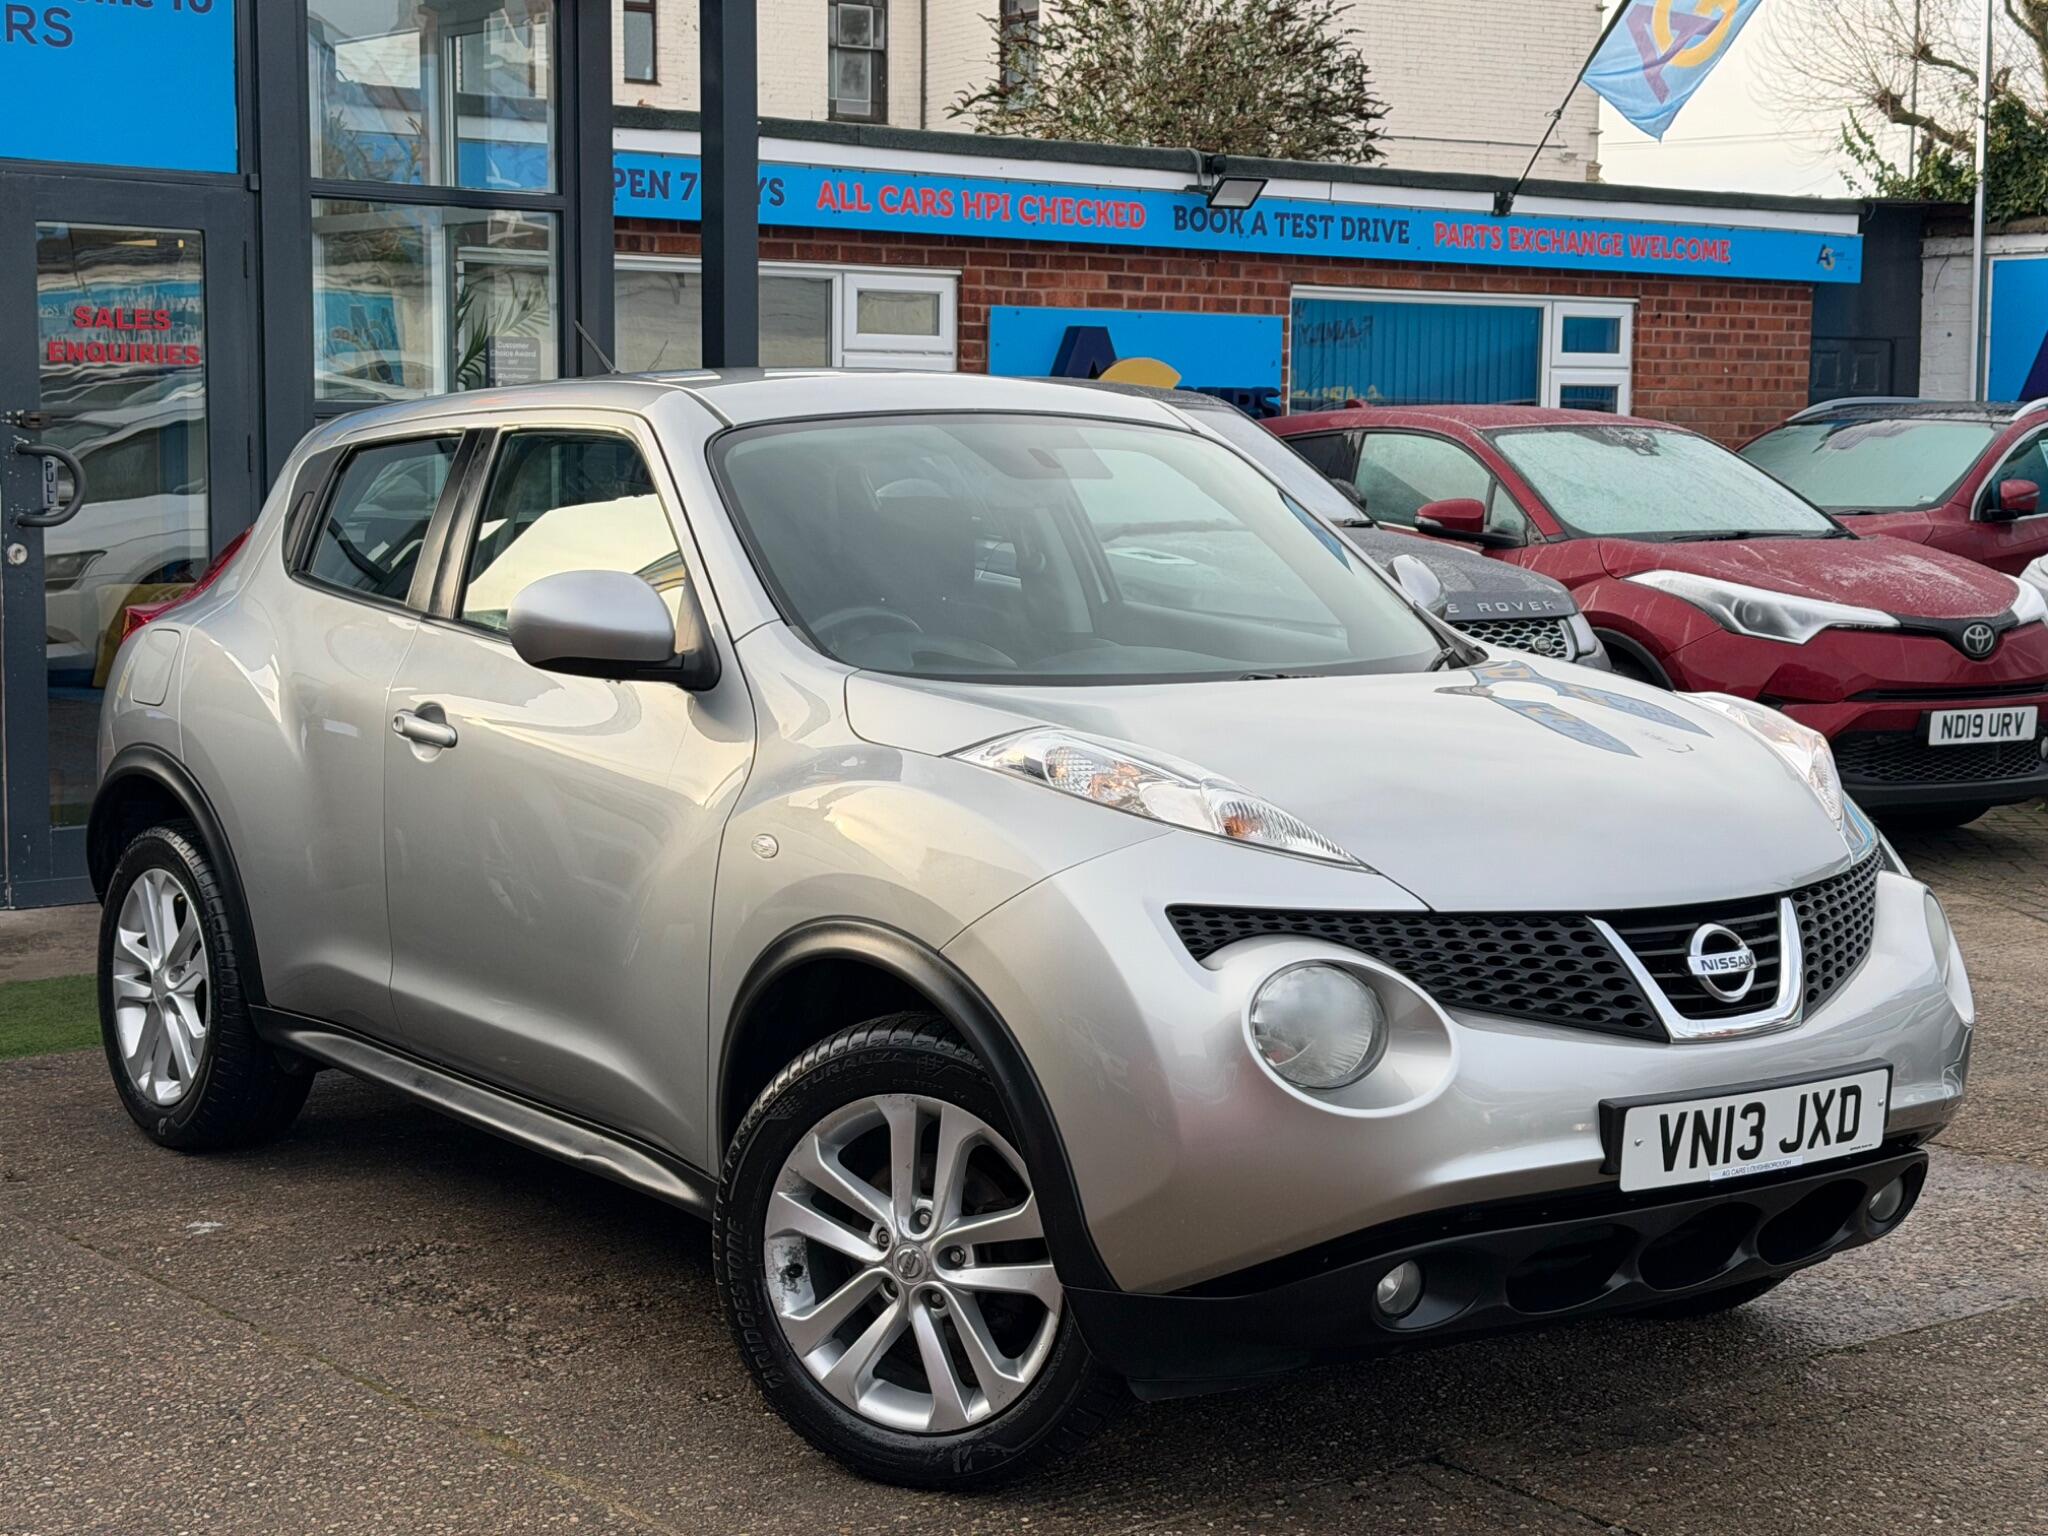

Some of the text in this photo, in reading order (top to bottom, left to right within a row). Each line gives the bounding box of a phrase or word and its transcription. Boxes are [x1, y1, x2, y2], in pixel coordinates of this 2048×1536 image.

[0, 4, 73, 48] RS
[613, 168, 785, 206] PEN 7 YS
[816, 180, 1146, 229] ALL CARS HPI CHECKED
[1173, 205, 1409, 244] BOOK A TEST DRIVE
[1433, 222, 1731, 263] PARTS EXCHANGE WELCOME
[73, 305, 173, 331] SALES
[47, 341, 200, 365] ENQUIRIES
[45, 461, 55, 504] PULL
[1477, 601, 1556, 613] ROVER
[1941, 714, 1984, 739] ND19
[1700, 954, 1753, 972] NISSAN
[1659, 1084, 1862, 1172] VN13 JXD
[1731, 1167, 1746, 1176] CARS
